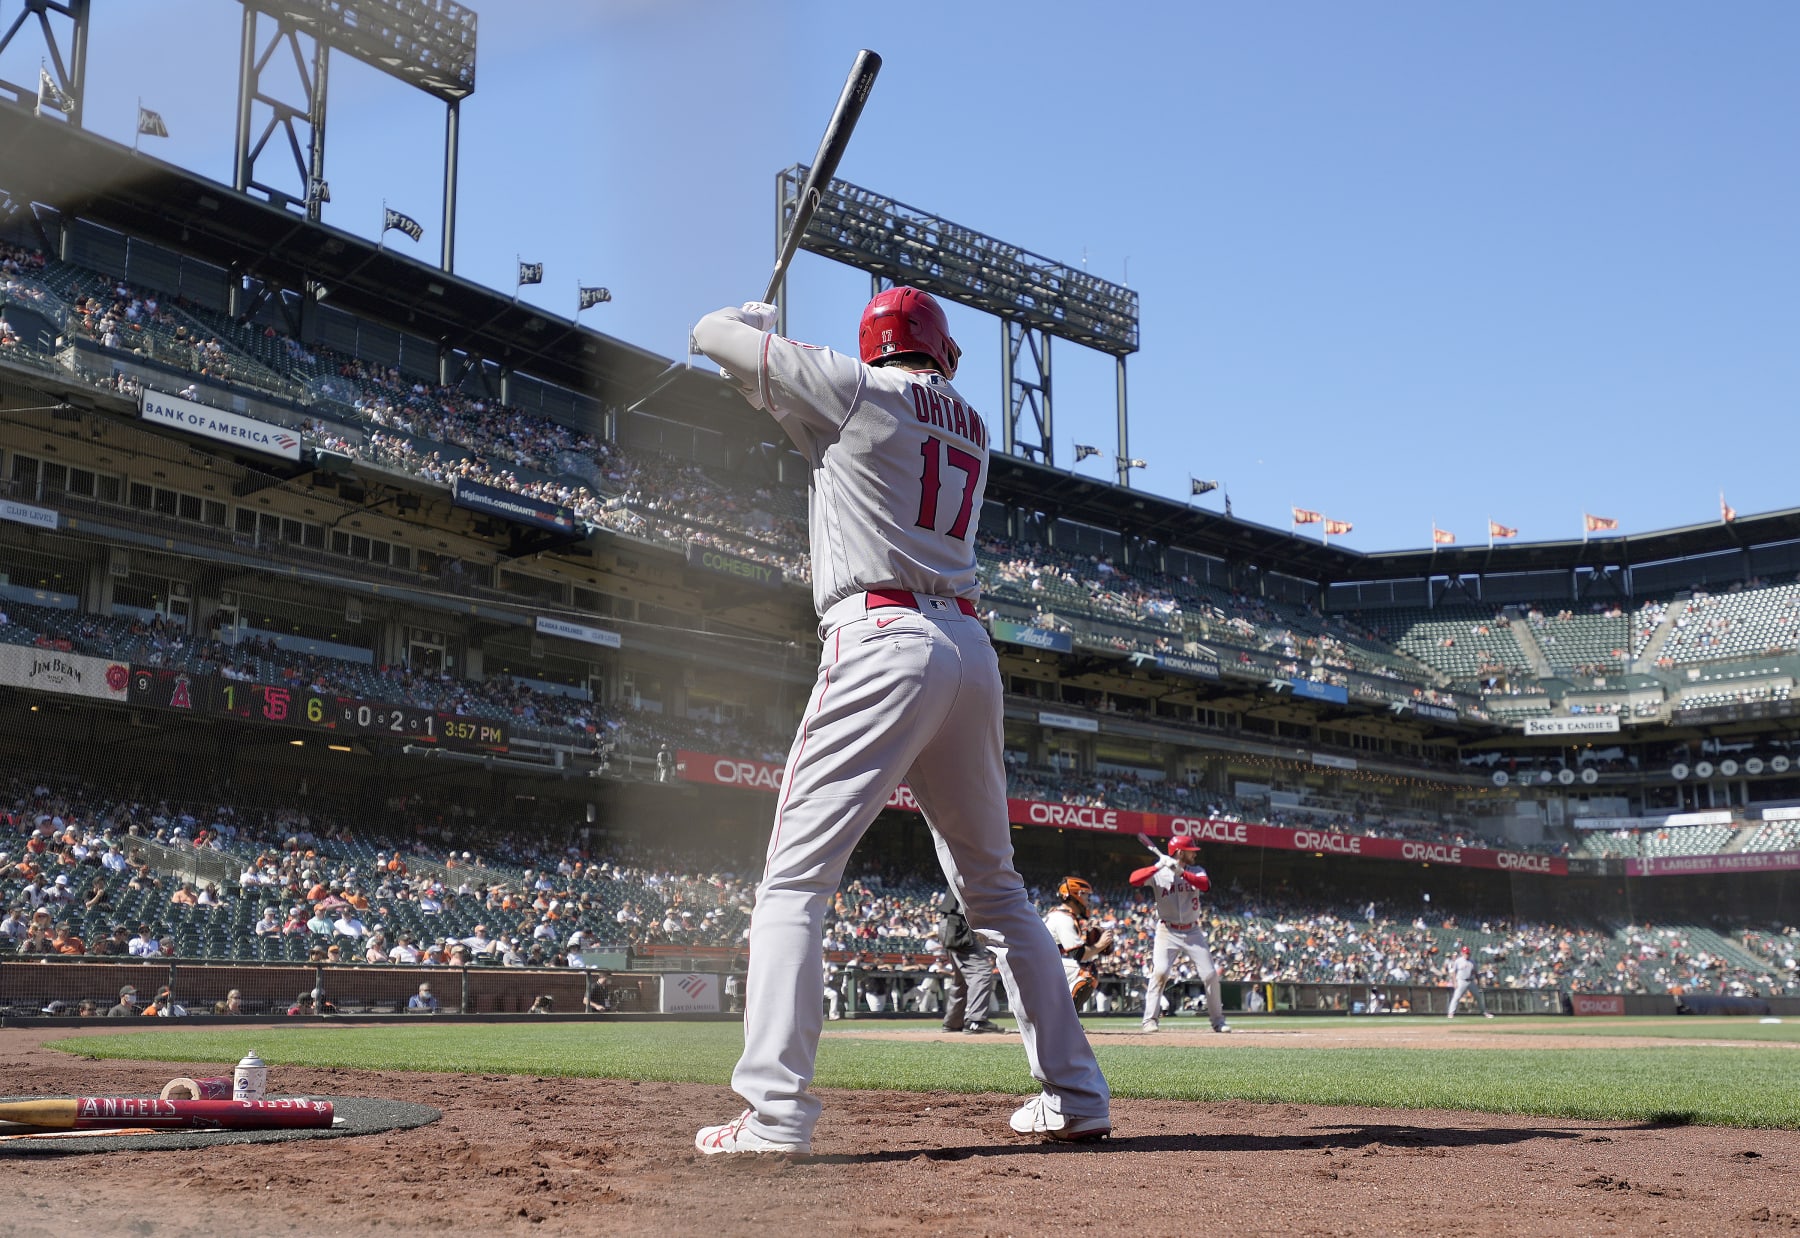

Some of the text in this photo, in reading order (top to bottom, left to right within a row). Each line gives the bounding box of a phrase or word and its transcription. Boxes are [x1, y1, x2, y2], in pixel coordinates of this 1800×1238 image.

[881, 329, 893, 343] 17
[145, 402, 269, 445] BANK OF AMERICA
[911, 382, 987, 452] OHTANI
[914, 435, 982, 542] 17
[6, 505, 54, 524] CLUB LEVEL
[702, 552, 772, 582] COHESITY
[1016, 627, 1054, 648] Alaska
[1164, 656, 1219, 676] KONICA MINOLTA
[138, 678, 147, 690] 9
[223, 685, 235, 711] 1
[307, 698, 323, 722] 6
[357, 705, 371, 727] 0
[390, 710, 404, 732] 2
[424, 715, 434, 736] 1
[445, 721, 502, 743] 3:57 PM
[1530, 720, 1613, 732] See's CANDIES
[714, 760, 783, 790] ORAC
[1029, 803, 1118, 830] ORACLE
[1171, 818, 1248, 843] ORACLE
[1294, 831, 1361, 853] ORACLE
[1402, 842, 1461, 863] ORACLE
[1497, 852, 1551, 872] ORACLE
[1775, 853, 1799, 866] THE
[1580, 1000, 1617, 1012] ORACLE
[79, 1098, 178, 1117] ANGELS
